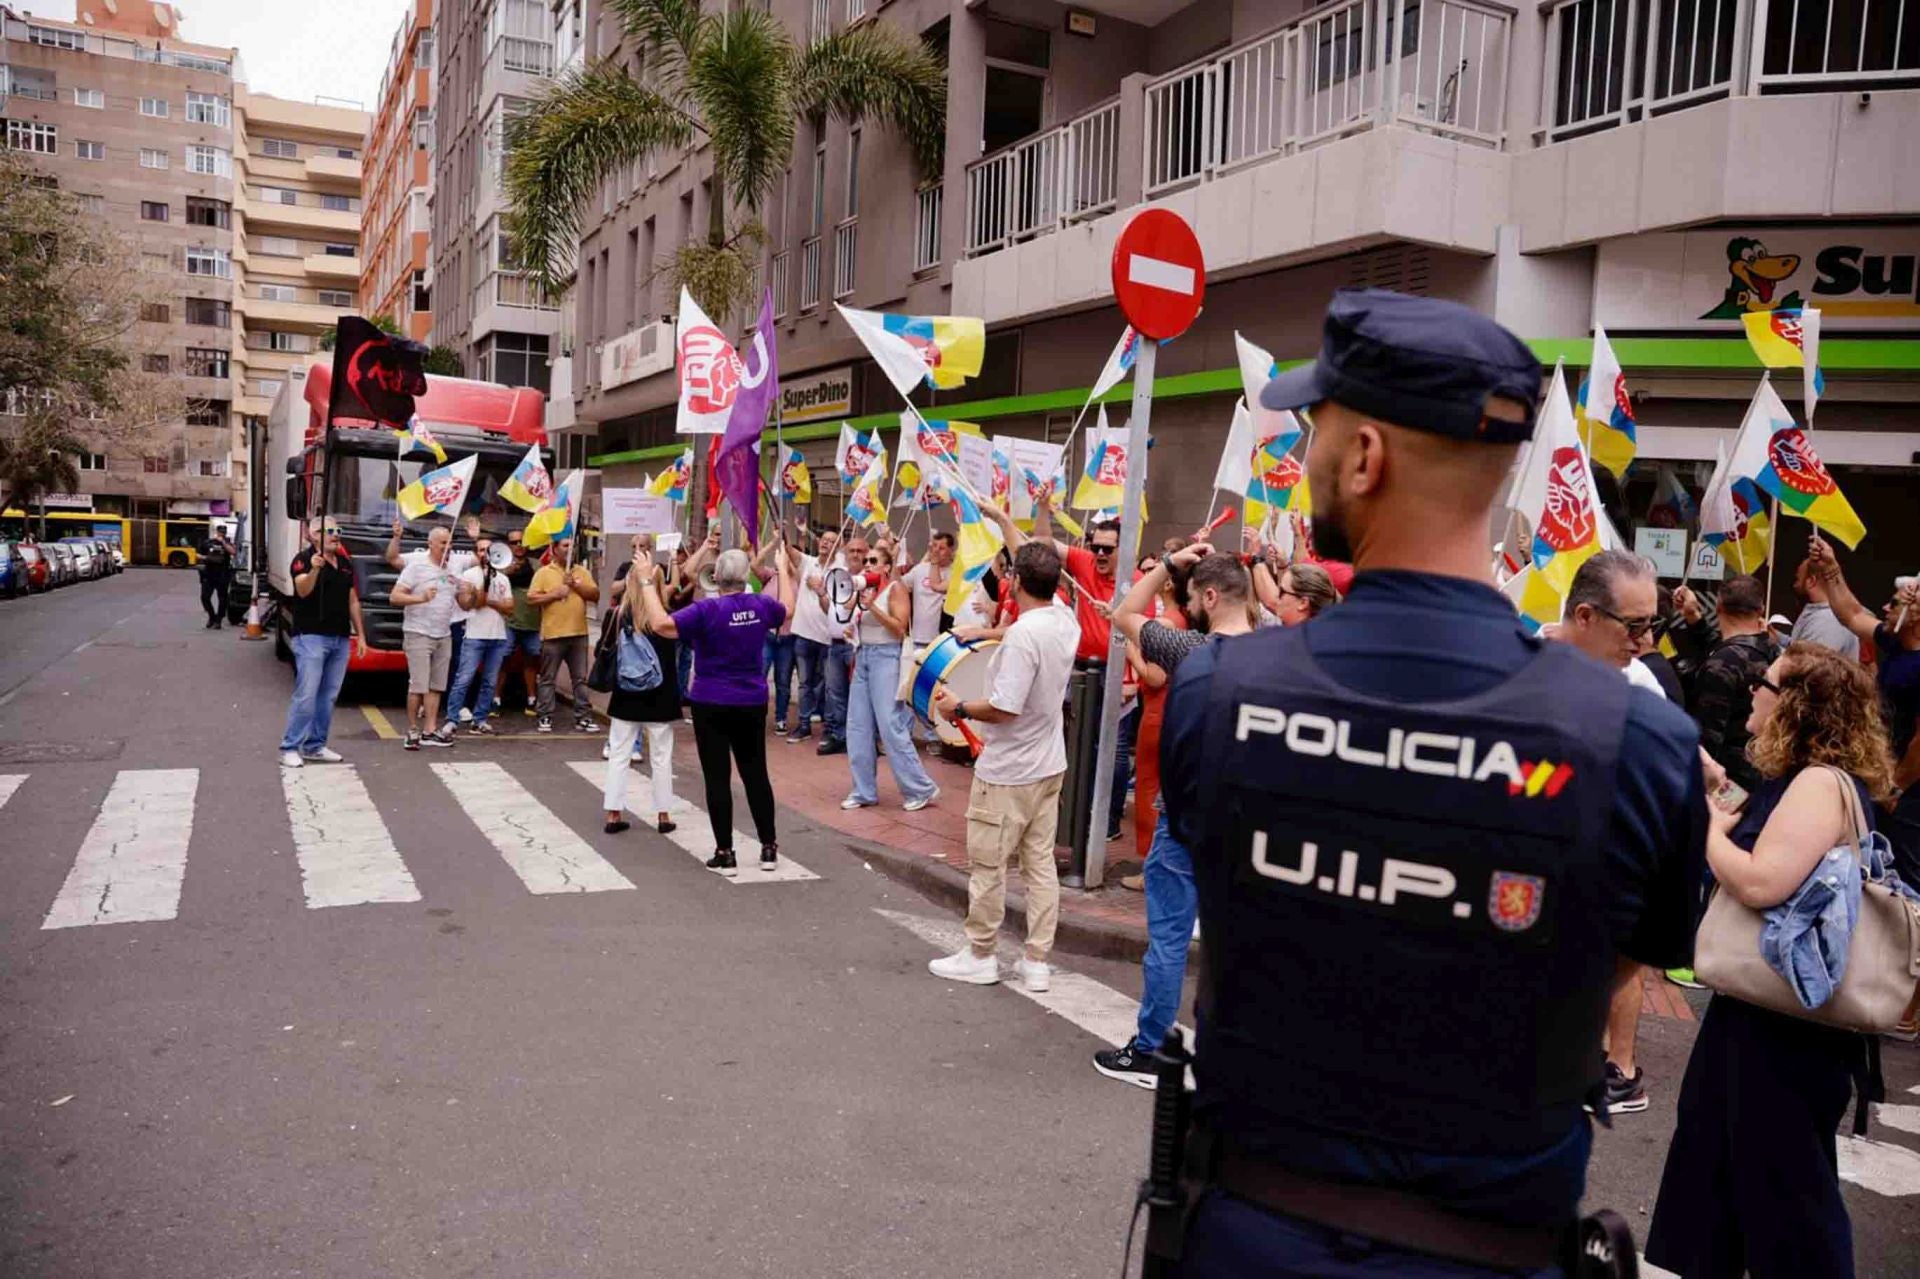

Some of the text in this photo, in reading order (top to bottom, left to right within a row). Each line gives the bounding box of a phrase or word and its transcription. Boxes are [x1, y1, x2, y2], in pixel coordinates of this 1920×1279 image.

[1811, 245, 1920, 305] Su
[783, 380, 848, 411] SuperDino
[1236, 703, 1525, 783] POLICIA
[1252, 830, 1472, 918] U.I.P.
